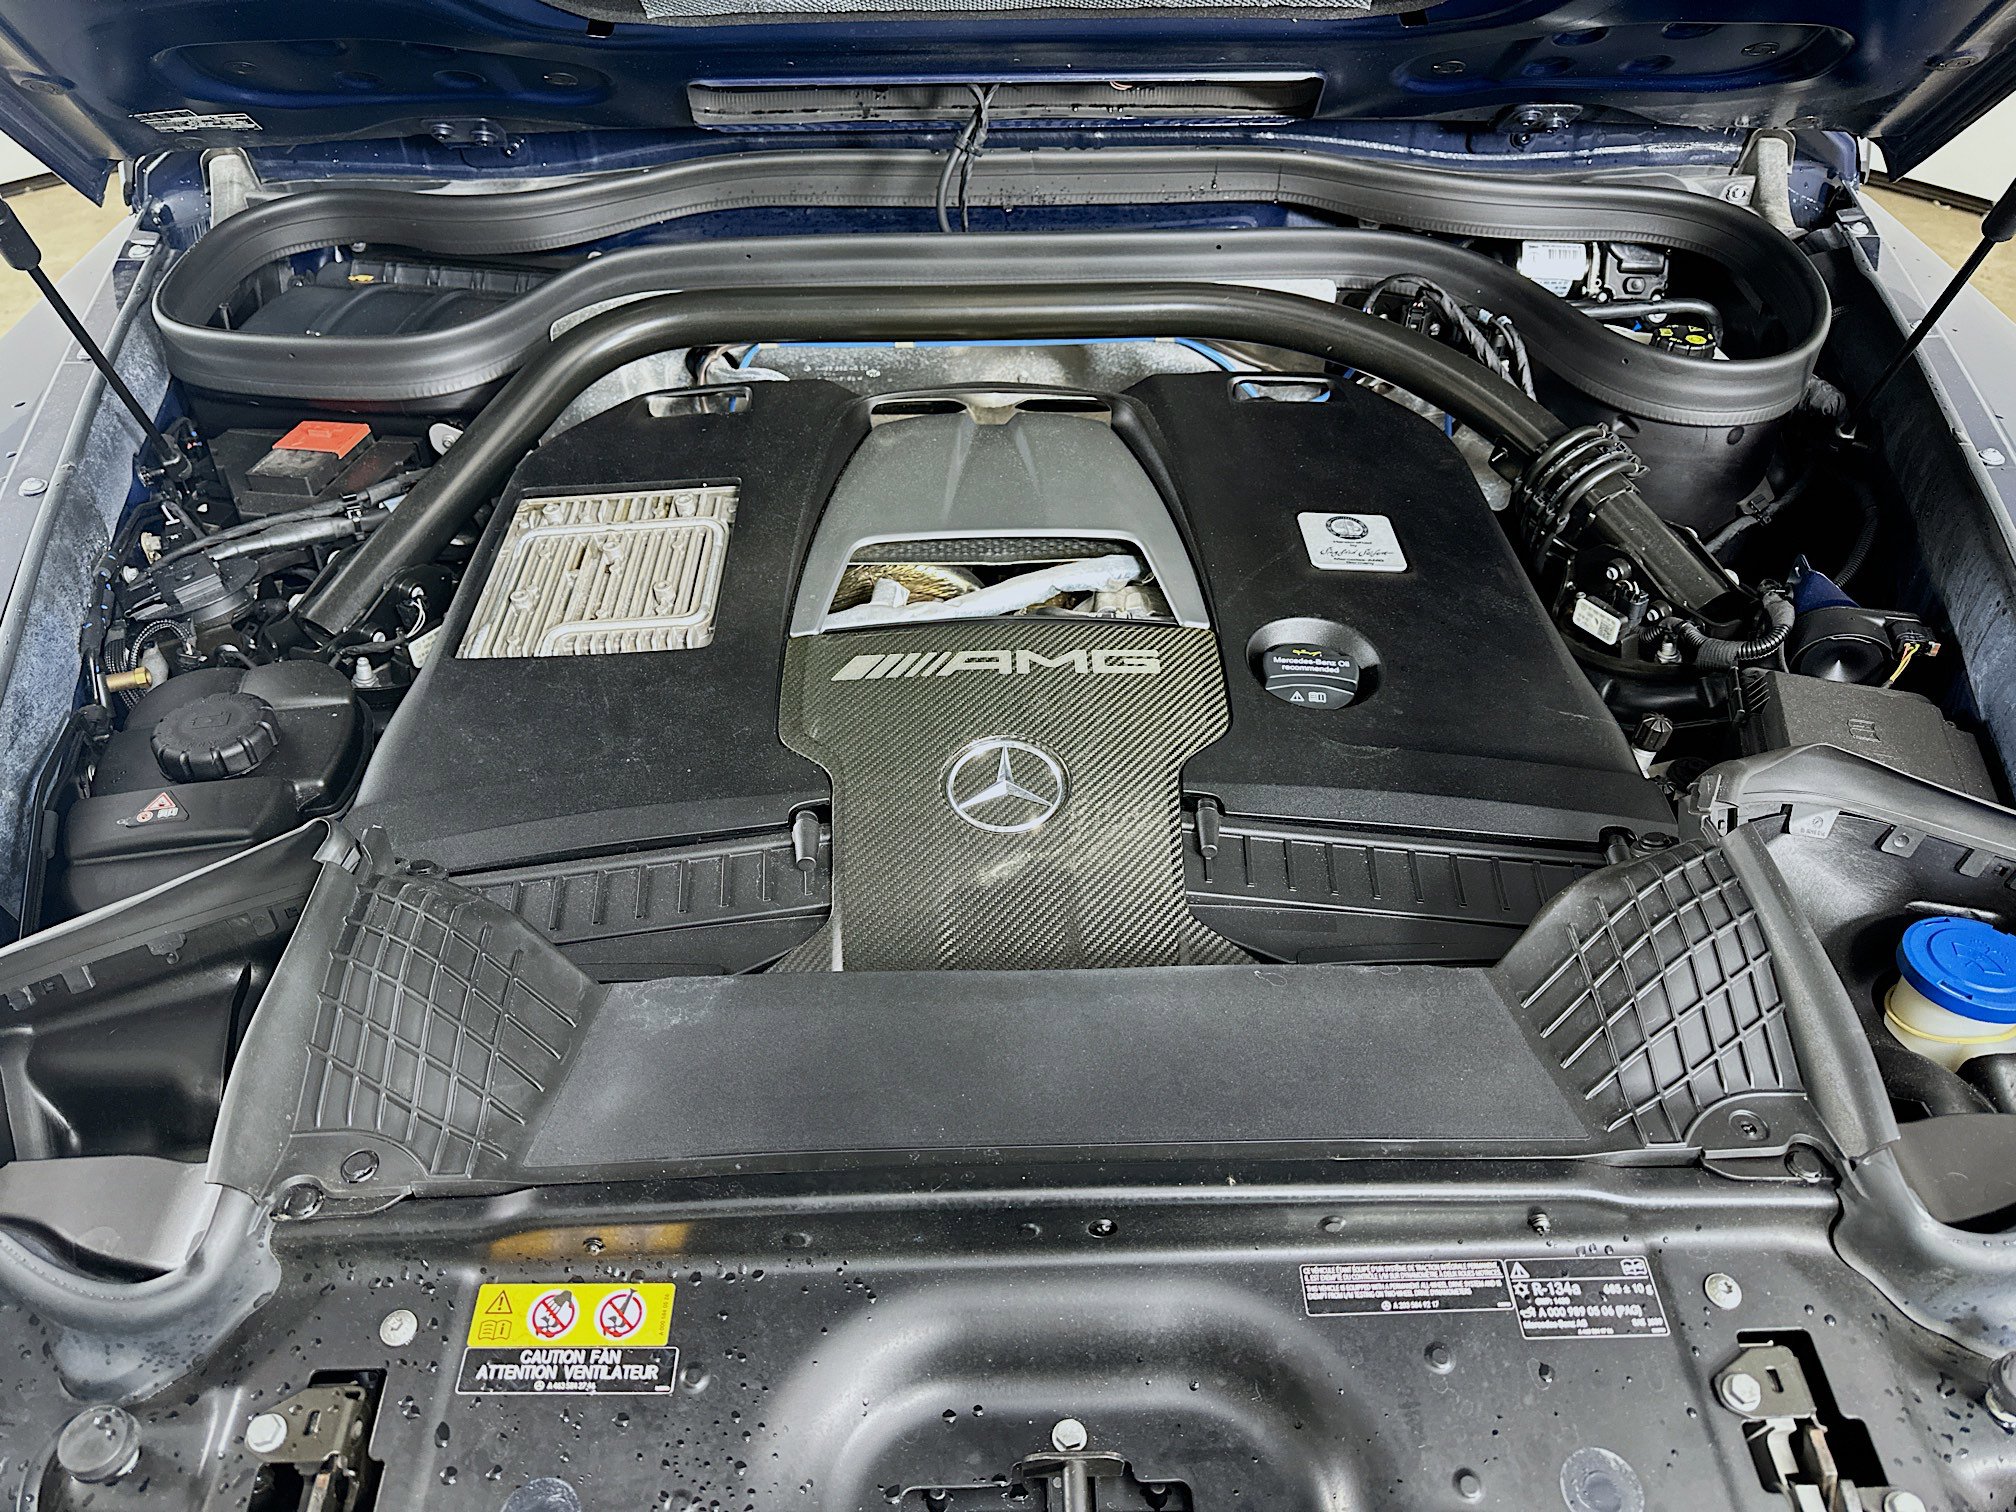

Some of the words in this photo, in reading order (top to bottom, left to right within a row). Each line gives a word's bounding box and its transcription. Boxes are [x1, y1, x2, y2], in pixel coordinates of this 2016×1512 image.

[938, 649, 1160, 675] AMG
[1273, 656, 1337, 667] Mercedes-Benz
[1338, 660, 1350, 668] Oil
[1281, 664, 1340, 674] recommended
[1532, 1282, 1582, 1296] R-134a
[1631, 1283, 1645, 1294] 10
[1538, 1307, 1547, 1318] A
[1547, 1306, 1566, 1317] 000
[1615, 1304, 1643, 1319] (PAG)
[520, 1349, 587, 1364] CAUTION
[589, 1349, 622, 1364] FAN
[475, 1364, 558, 1380] ATTENTION
[563, 1364, 659, 1380] VENTILATEUR
